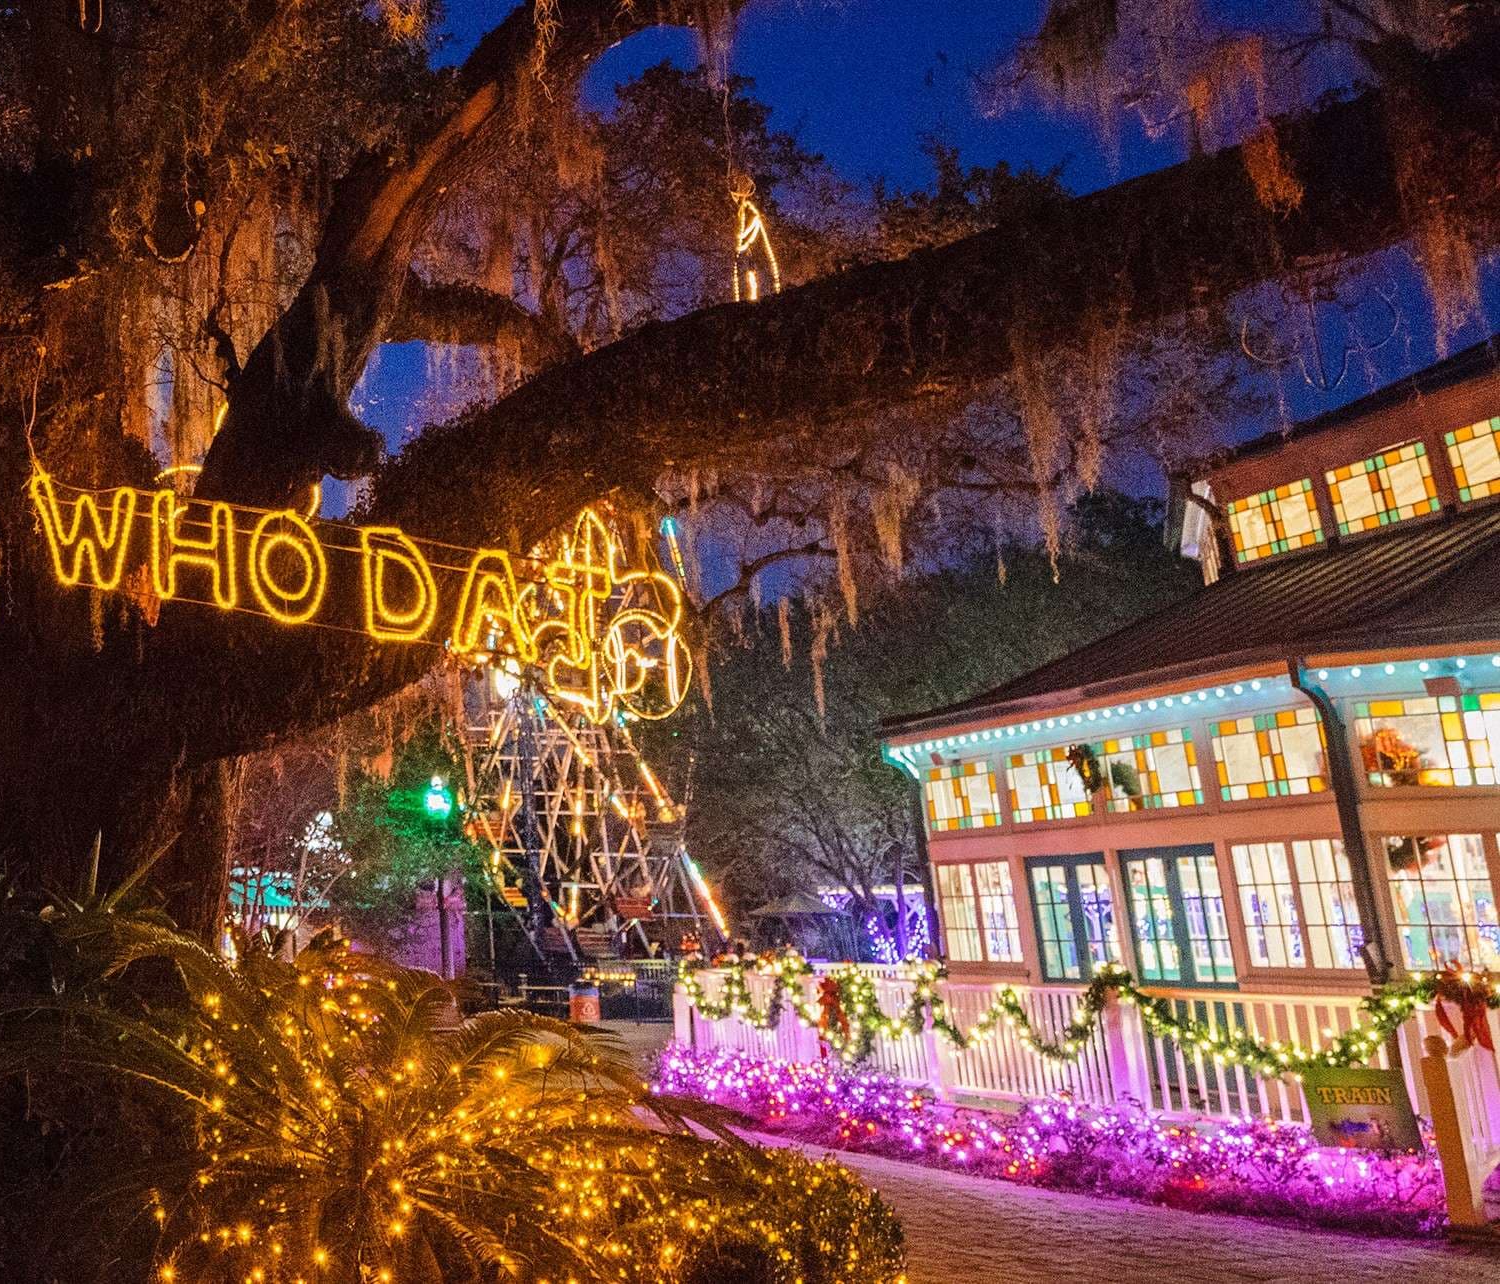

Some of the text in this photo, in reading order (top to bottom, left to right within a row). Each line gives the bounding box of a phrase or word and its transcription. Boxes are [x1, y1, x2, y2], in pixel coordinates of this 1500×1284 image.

[31, 472, 611, 669] WHO DAT
[1316, 1087, 1392, 1105] TRAIN
